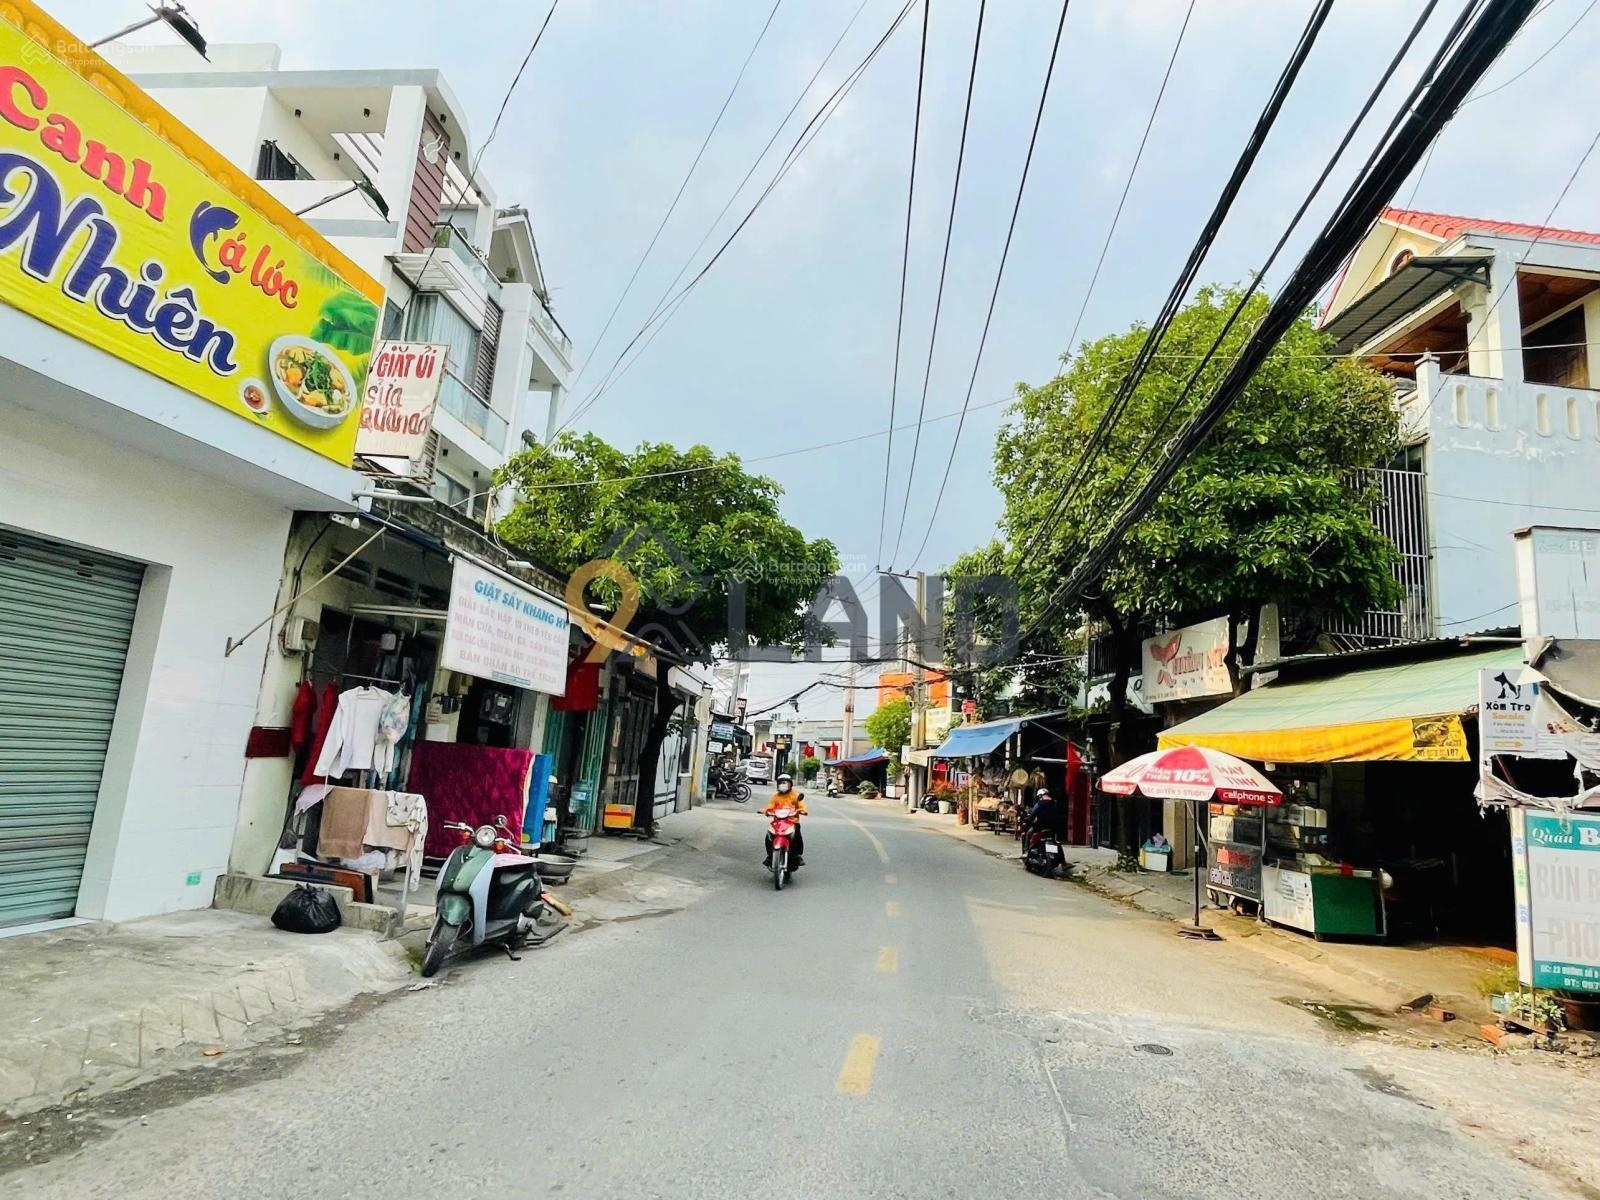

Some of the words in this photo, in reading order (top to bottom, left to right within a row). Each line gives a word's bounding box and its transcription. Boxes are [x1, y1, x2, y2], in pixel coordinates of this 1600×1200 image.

[0, 66, 167, 222] Canh
[0, 150, 238, 376] Nhiên
[523, 602, 554, 626] KHANG
